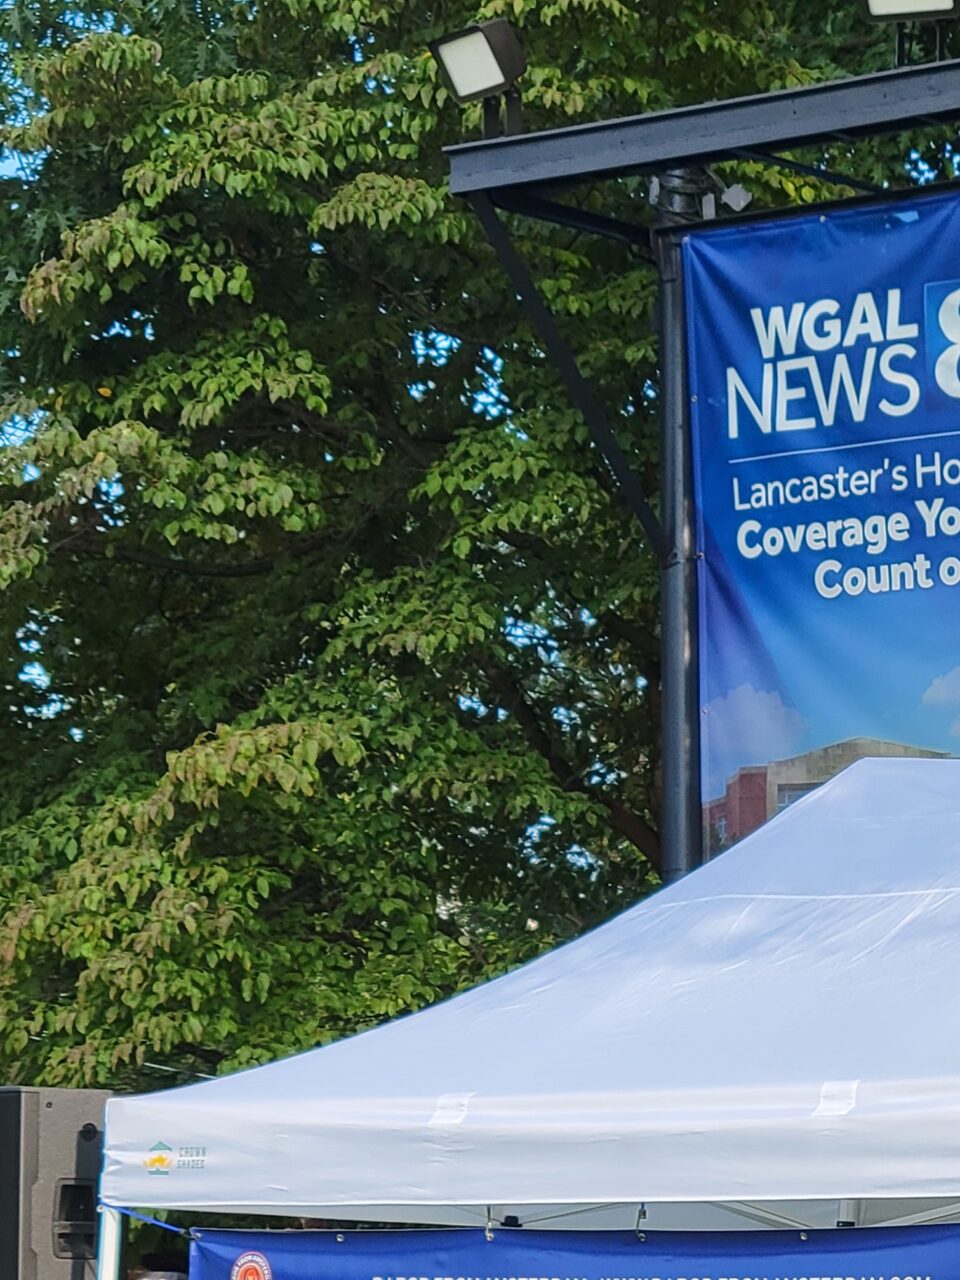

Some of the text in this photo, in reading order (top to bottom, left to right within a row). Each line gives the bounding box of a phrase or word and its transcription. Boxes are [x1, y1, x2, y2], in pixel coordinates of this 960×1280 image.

[750, 288, 919, 359] WGAL
[726, 343, 920, 439] NEWS
[732, 458, 908, 510] Lancaster's
[737, 512, 910, 559] Coverage
[815, 554, 934, 599] Count
[177, 1159, 205, 1169] SHADES
[179, 1146, 206, 1158] CROWN
